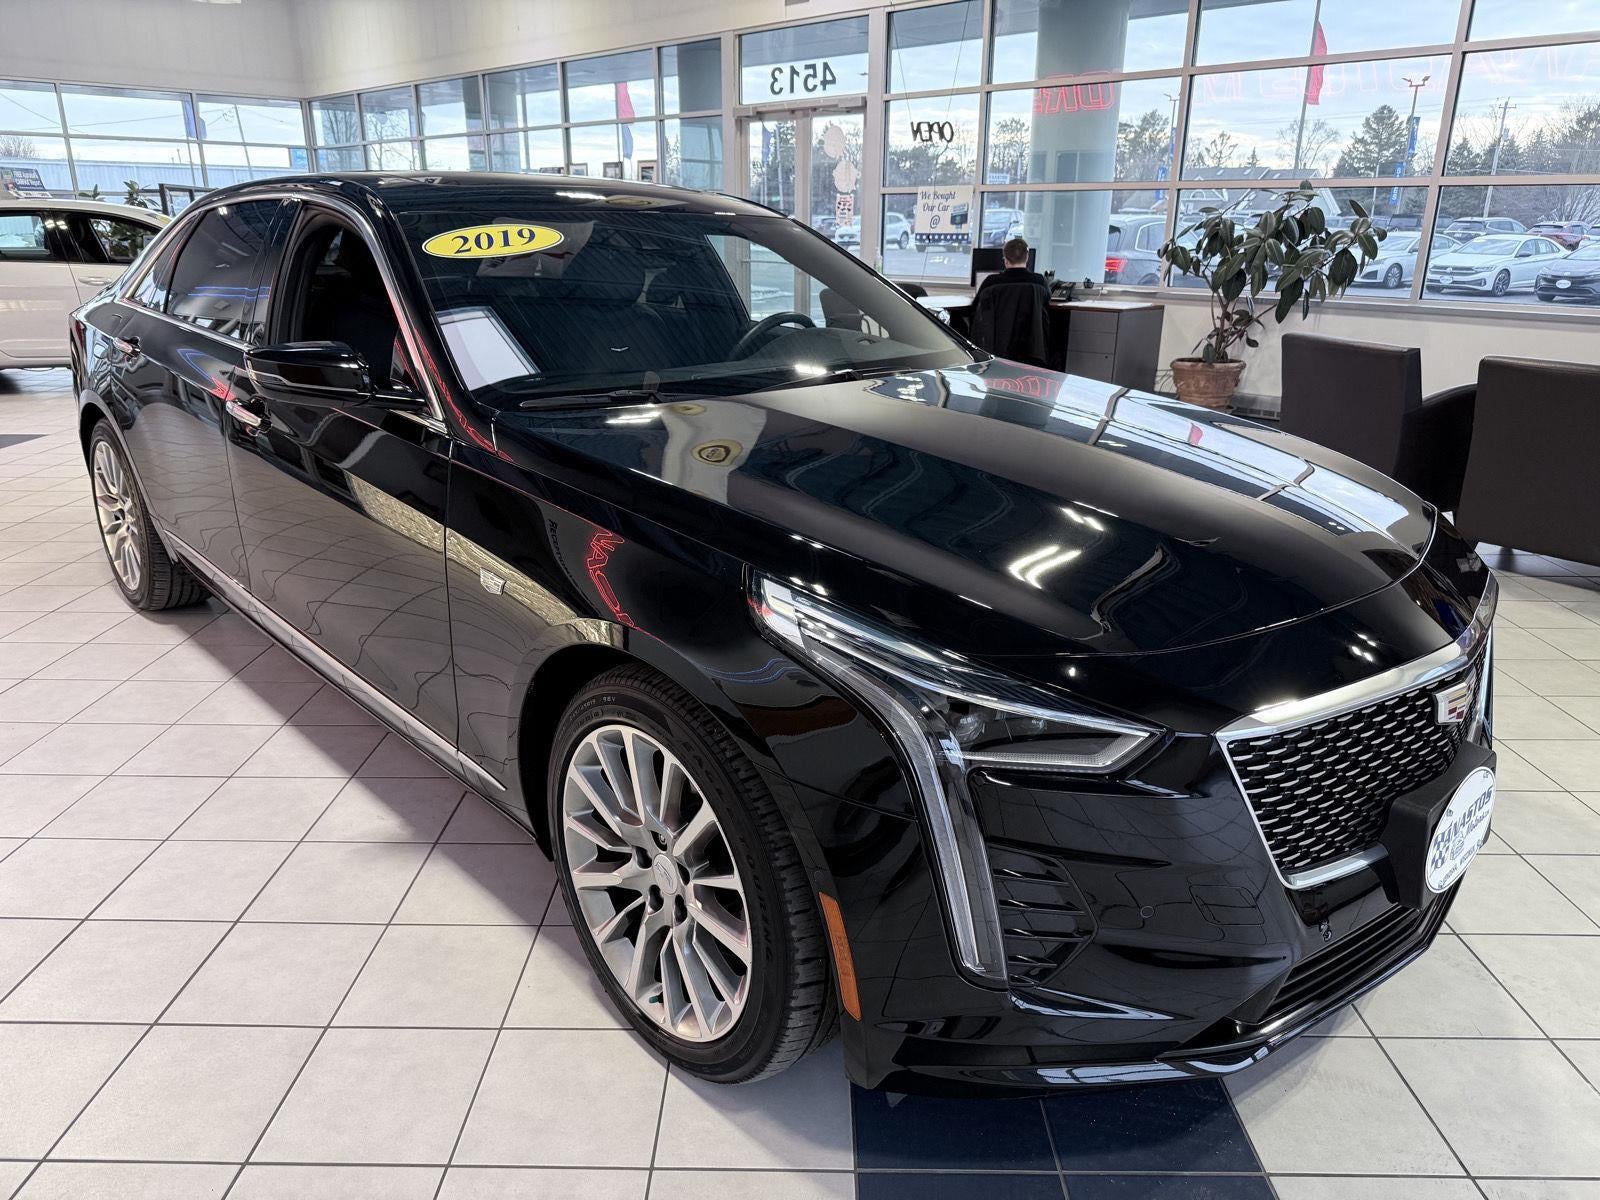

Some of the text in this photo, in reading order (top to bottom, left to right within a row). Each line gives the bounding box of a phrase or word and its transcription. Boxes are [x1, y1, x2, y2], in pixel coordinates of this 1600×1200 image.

[920, 190, 957, 202] We Bought
[922, 202, 936, 212] Our
[937, 202, 951, 212] Car
[930, 215, 940, 229] @
[451, 228, 536, 254] 2019
